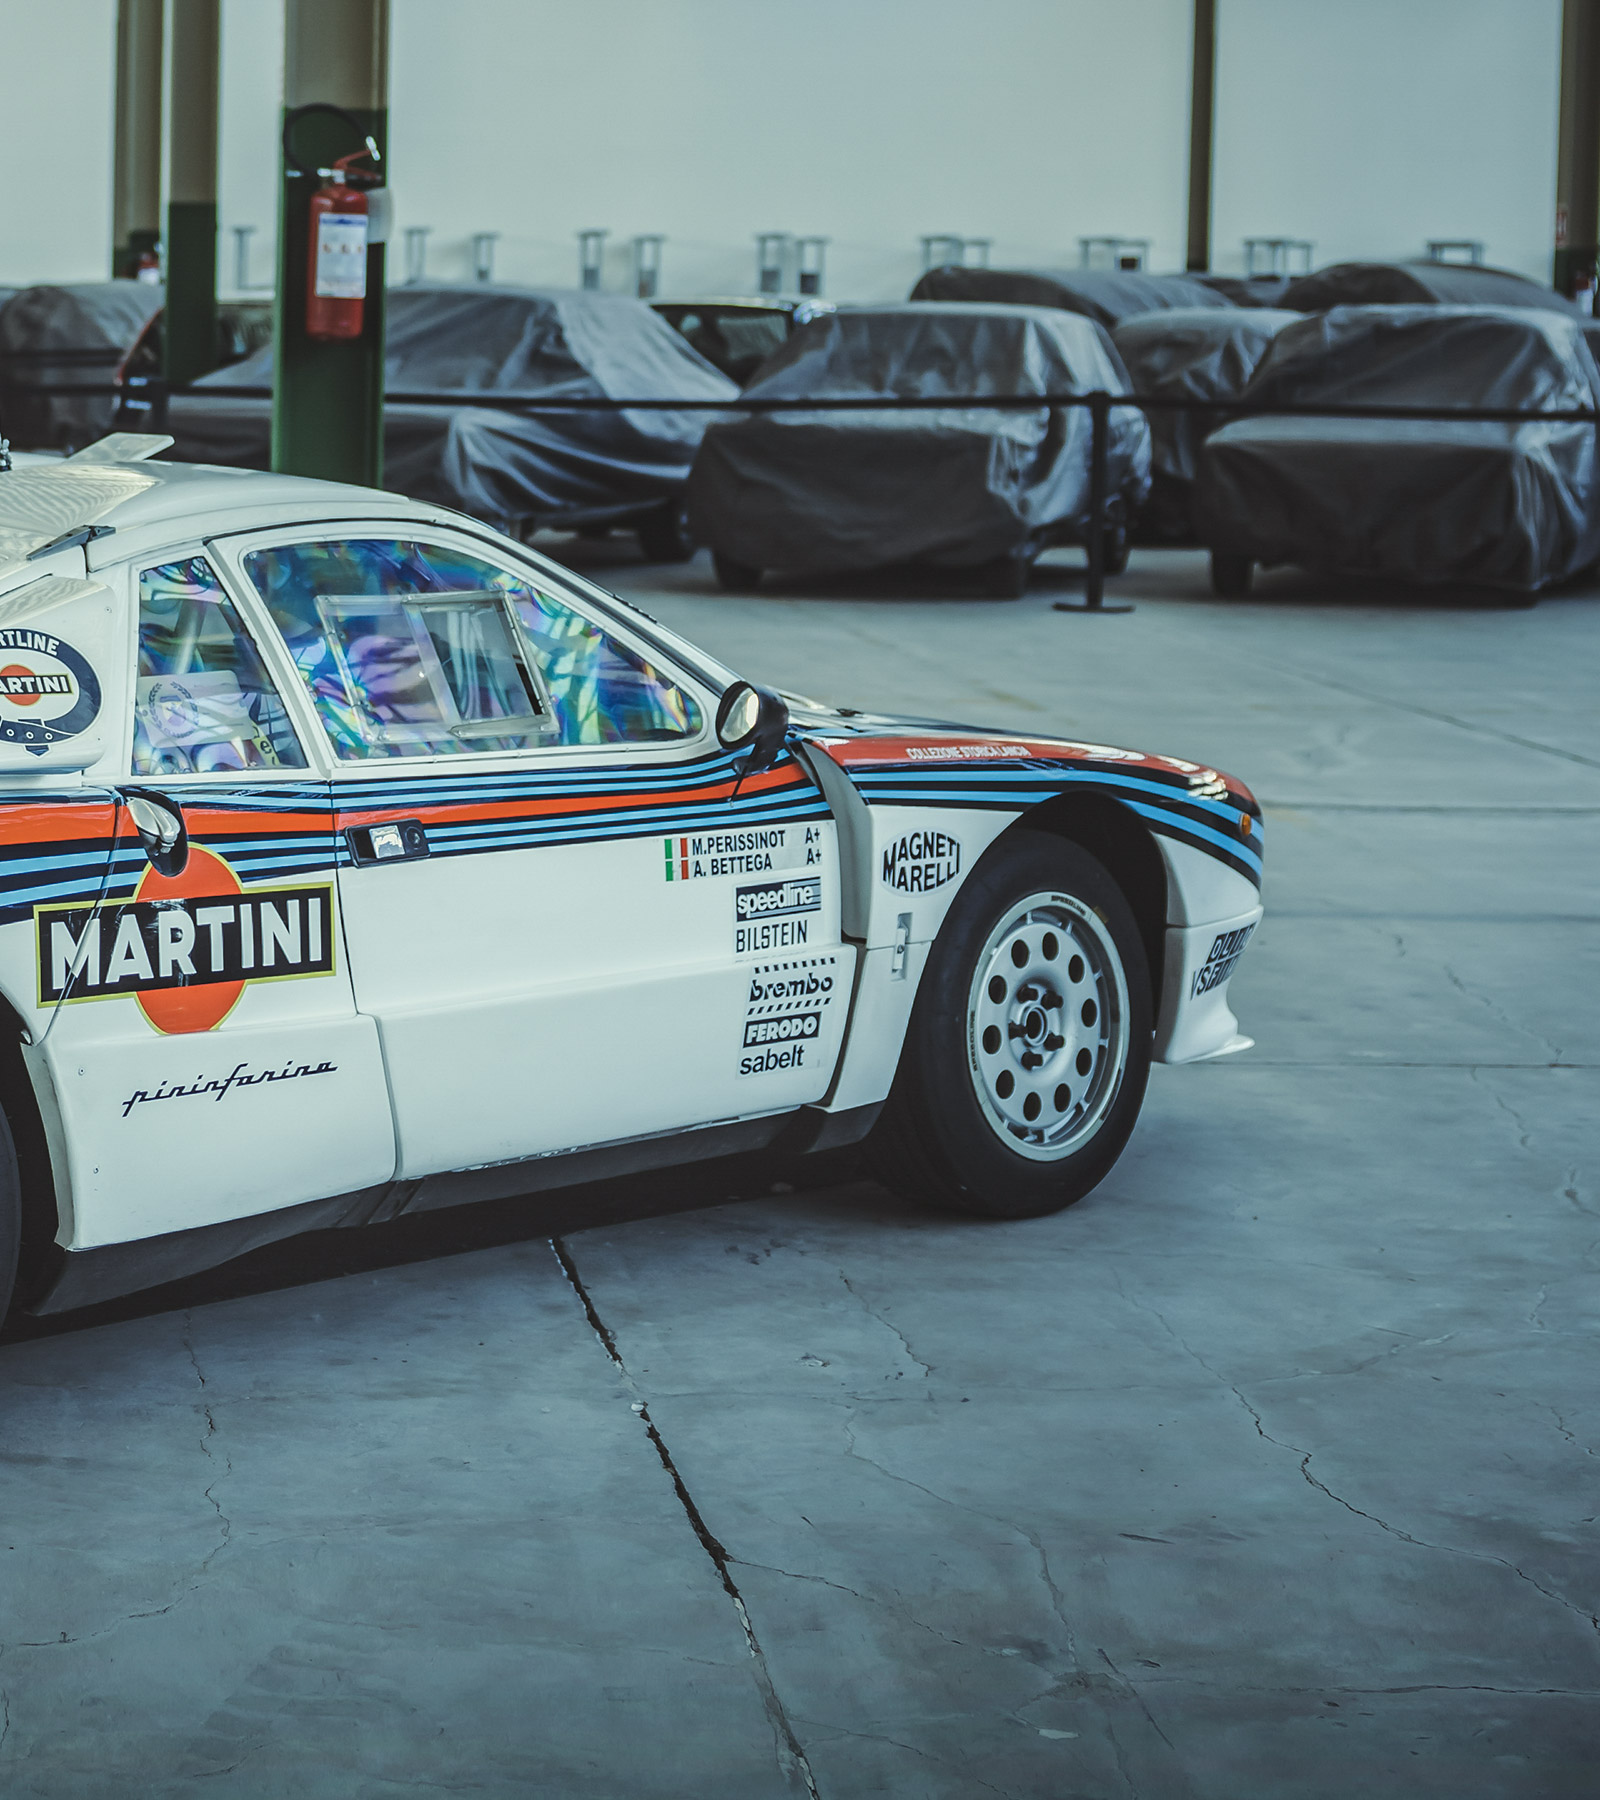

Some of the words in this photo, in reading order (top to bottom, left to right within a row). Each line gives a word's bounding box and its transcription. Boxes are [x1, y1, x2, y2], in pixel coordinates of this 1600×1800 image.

[905, 746, 963, 760] COLLEZIONE
[960, 746, 999, 758] STORICA
[996, 746, 1032, 757] LANCIA
[692, 830, 786, 856] M.PERISSINOT
[805, 827, 821, 844] A+
[883, 831, 960, 868] MAGNETI
[693, 860, 707, 878] A.
[711, 853, 773, 876] BETTEGA
[806, 848, 822, 865] A+
[883, 857, 960, 892] MARELLI
[737, 883, 814, 918] speedline
[50, 898, 322, 990] MARTINI
[736, 919, 808, 953] BILSTEIN
[749, 972, 833, 1002] brembo
[746, 1015, 818, 1044] FERODO
[739, 1044, 804, 1075] sabelt
[122, 1061, 338, 1117] pininfarina
